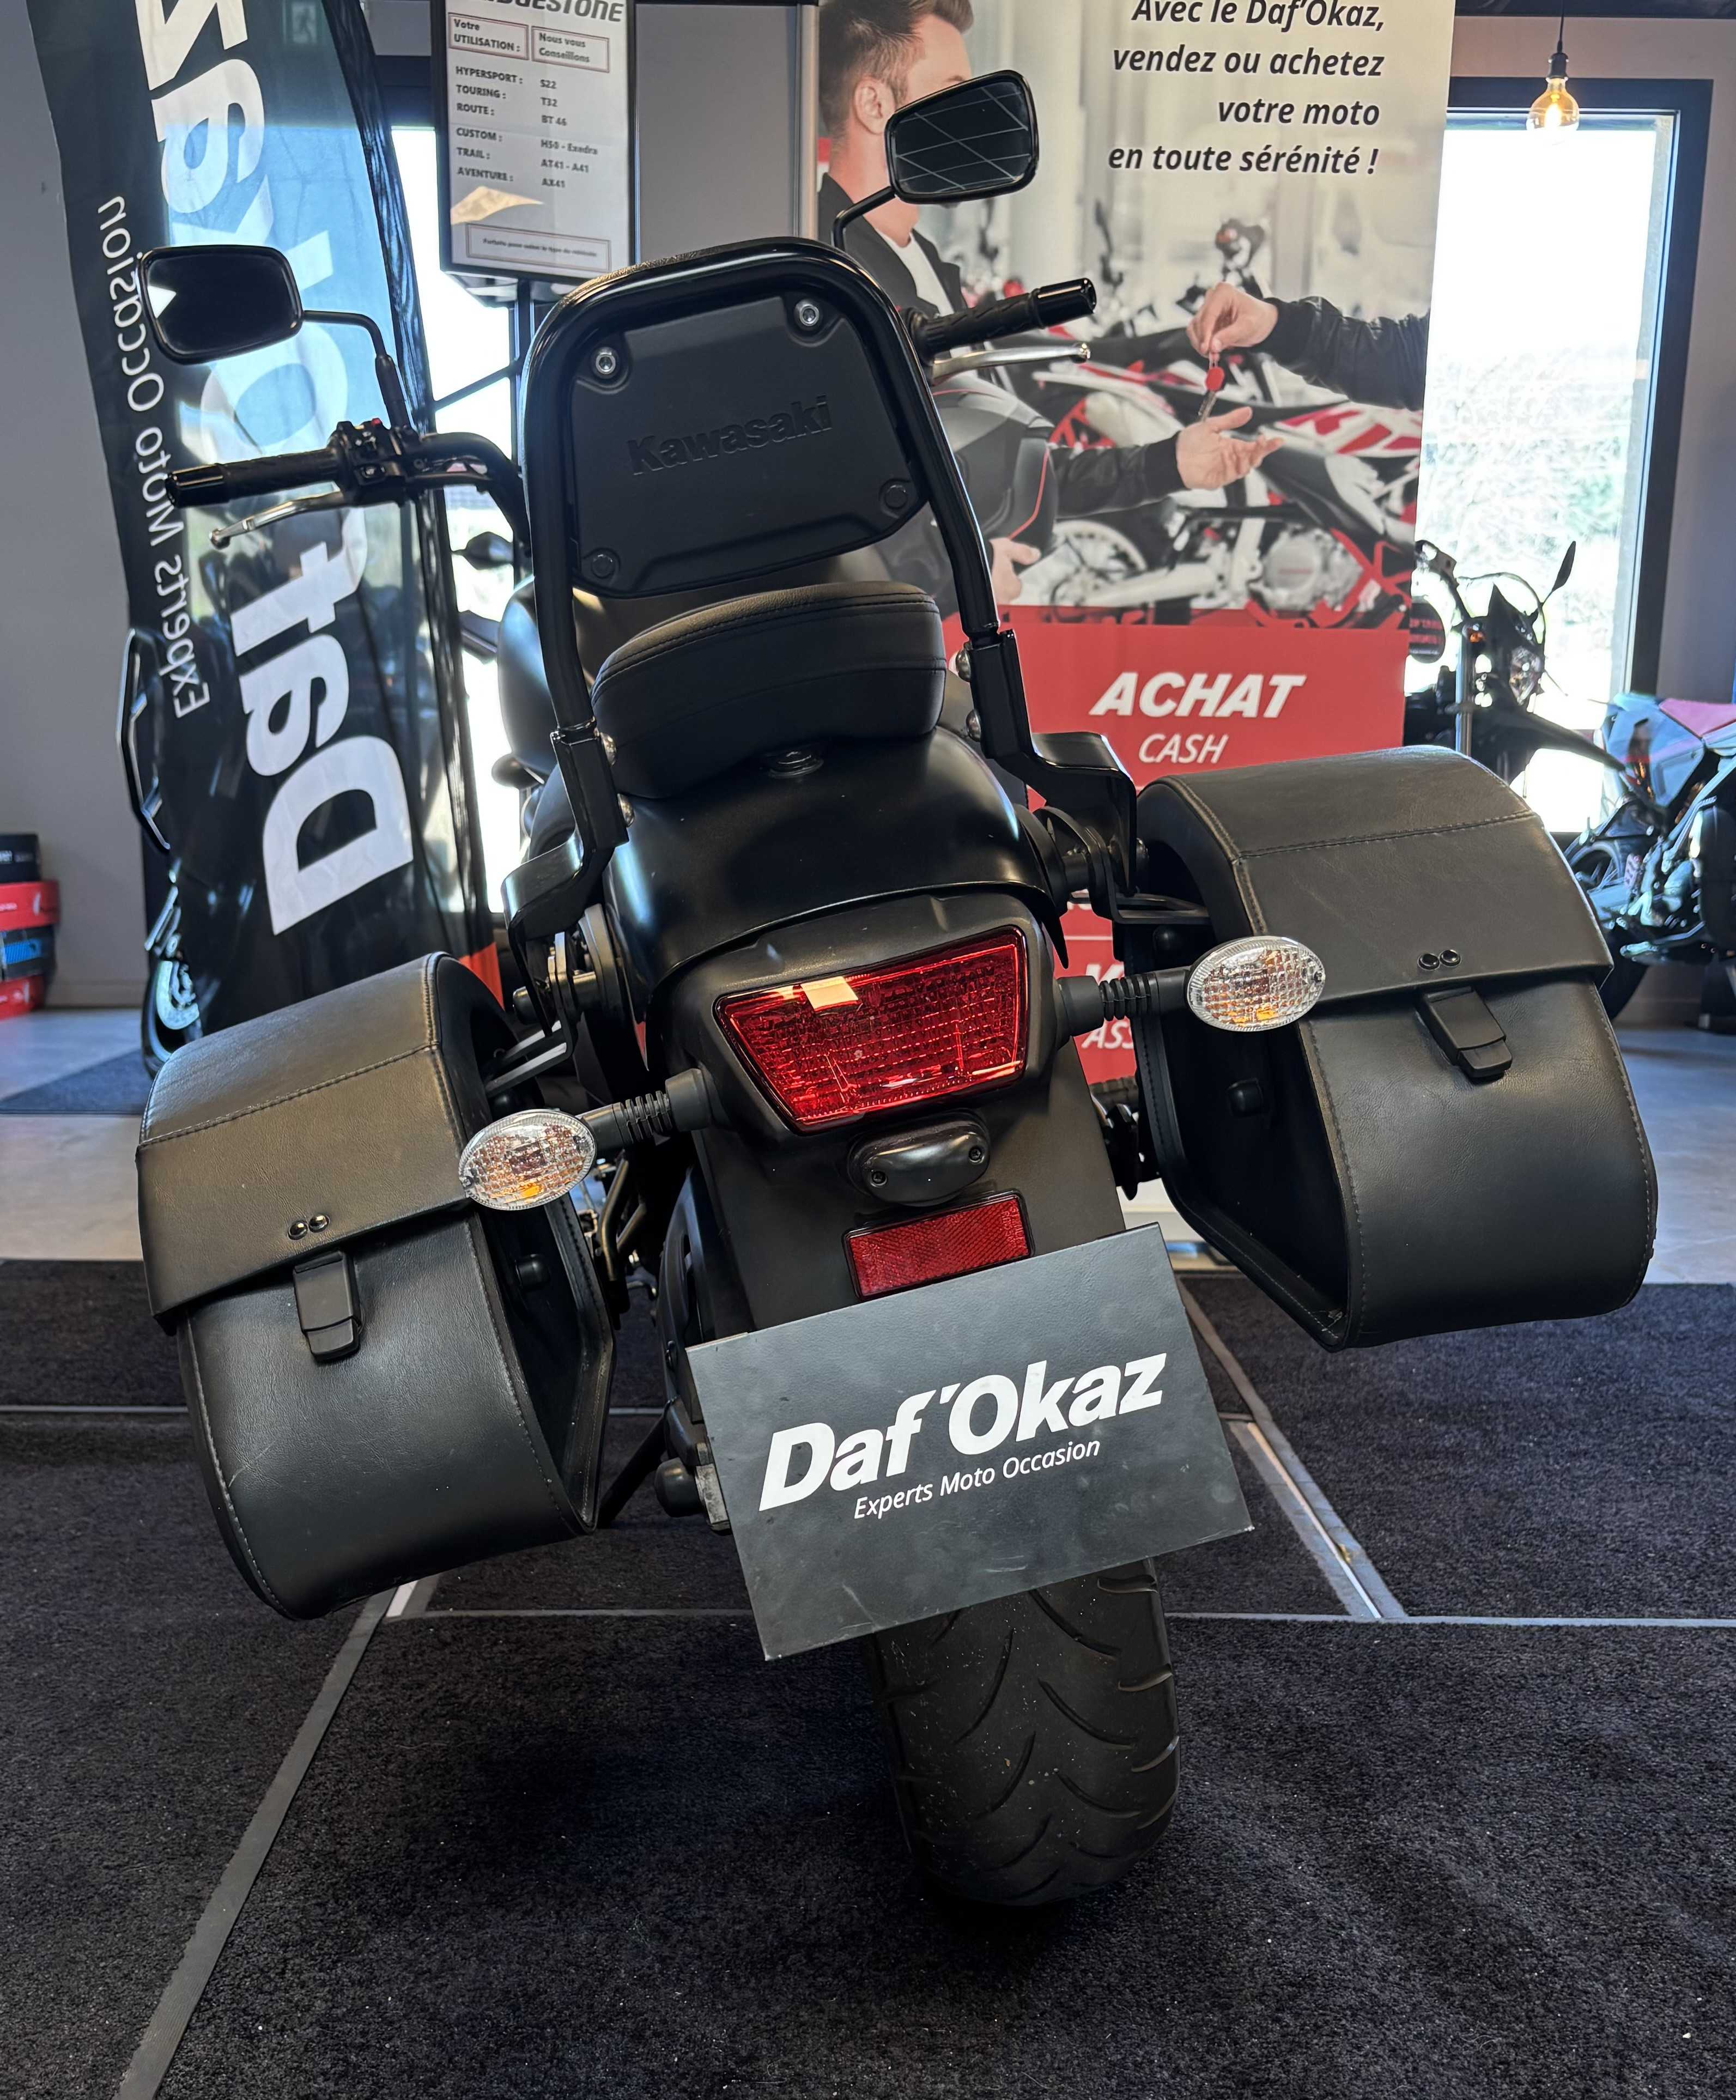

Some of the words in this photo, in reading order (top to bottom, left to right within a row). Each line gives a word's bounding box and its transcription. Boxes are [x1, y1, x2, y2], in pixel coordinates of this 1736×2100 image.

[1132, 0, 1203, 22] Avec
[1210, 0, 1237, 23] le
[453, 19, 480, 31] Votre
[454, 34, 514, 51] UTILISATION
[539, 33, 562, 44] Nous
[564, 39, 586, 47] vous
[539, 47, 590, 62] Conseillons
[1113, 45, 1217, 72] vendez
[1224, 52, 1260, 74] ou
[1270, 47, 1385, 76] achetez
[456, 66, 517, 83] HYPERSPORT
[541, 79, 556, 89] S22
[456, 84, 500, 98] TOURING
[541, 97, 557, 107] T32
[457, 103, 489, 114] ROUTE
[542, 115, 554, 124] BT
[1218, 98, 1294, 124] votre
[1303, 101, 1380, 125] moto
[456, 128, 496, 141] CUSTOM
[457, 147, 484, 159] TRAIL
[541, 159, 564, 169] AT41
[1108, 149, 1143, 169] en
[1152, 145, 1231, 172] toute
[1239, 144, 1361, 174] sérénité
[457, 167, 508, 181] AVENTURE
[627, 393, 833, 475] Kawasaki
[1089, 672, 1306, 718] ACHAT
[1138, 732, 1229, 763] CASH
[854, 1482, 933, 1519] Experts
[940, 1465, 996, 1497] Moto
[1003, 1440, 1101, 1479] Occasion
